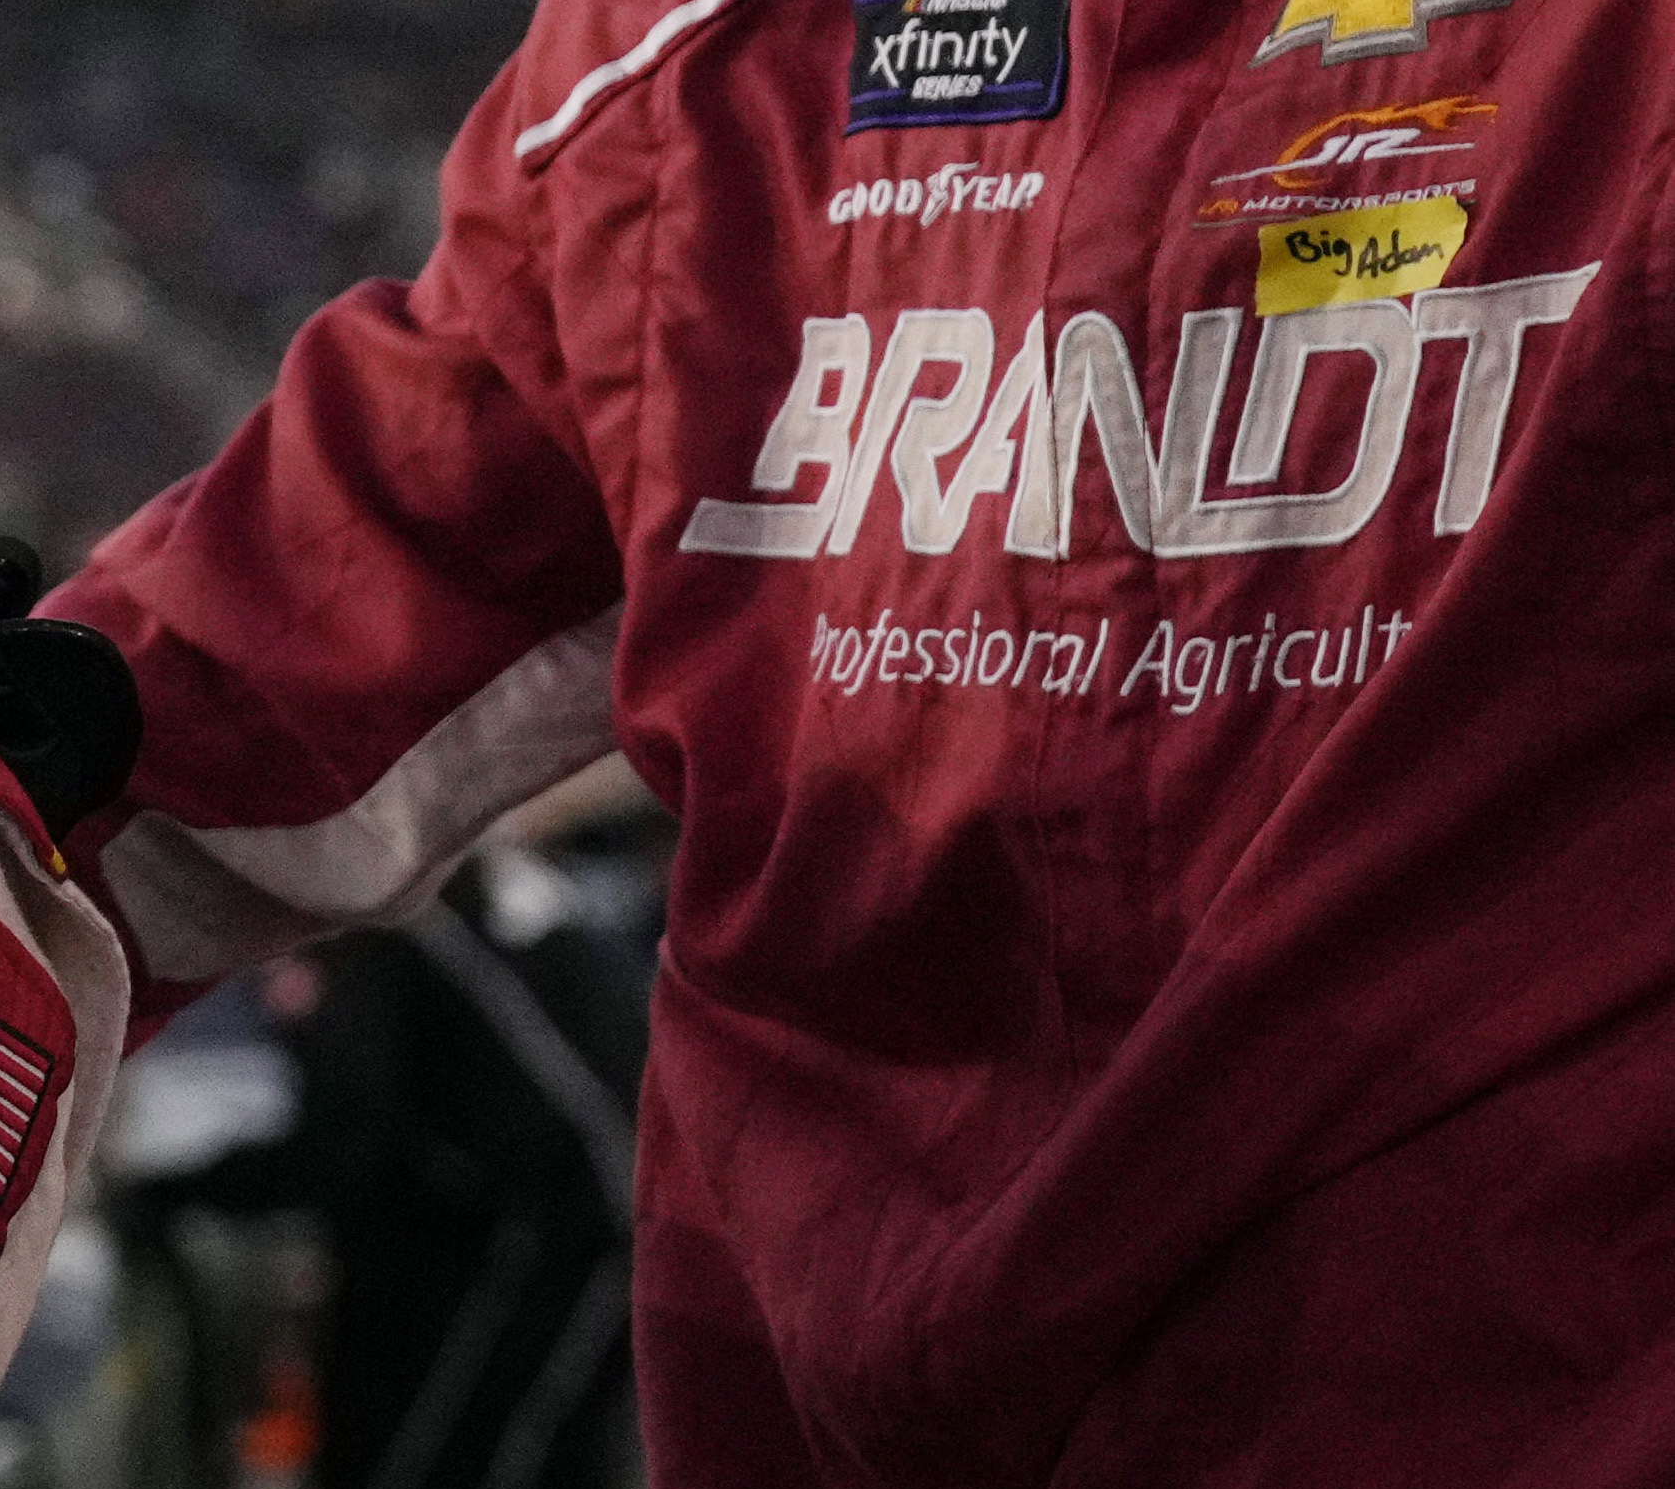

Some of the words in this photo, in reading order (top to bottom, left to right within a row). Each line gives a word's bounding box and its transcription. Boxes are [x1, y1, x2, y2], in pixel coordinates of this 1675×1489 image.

[869, 17, 1028, 89] xfinity
[1285, 229, 1353, 277] Big
[1356, 227, 1445, 280] Adam
[678, 261, 1602, 561] BRANDT
